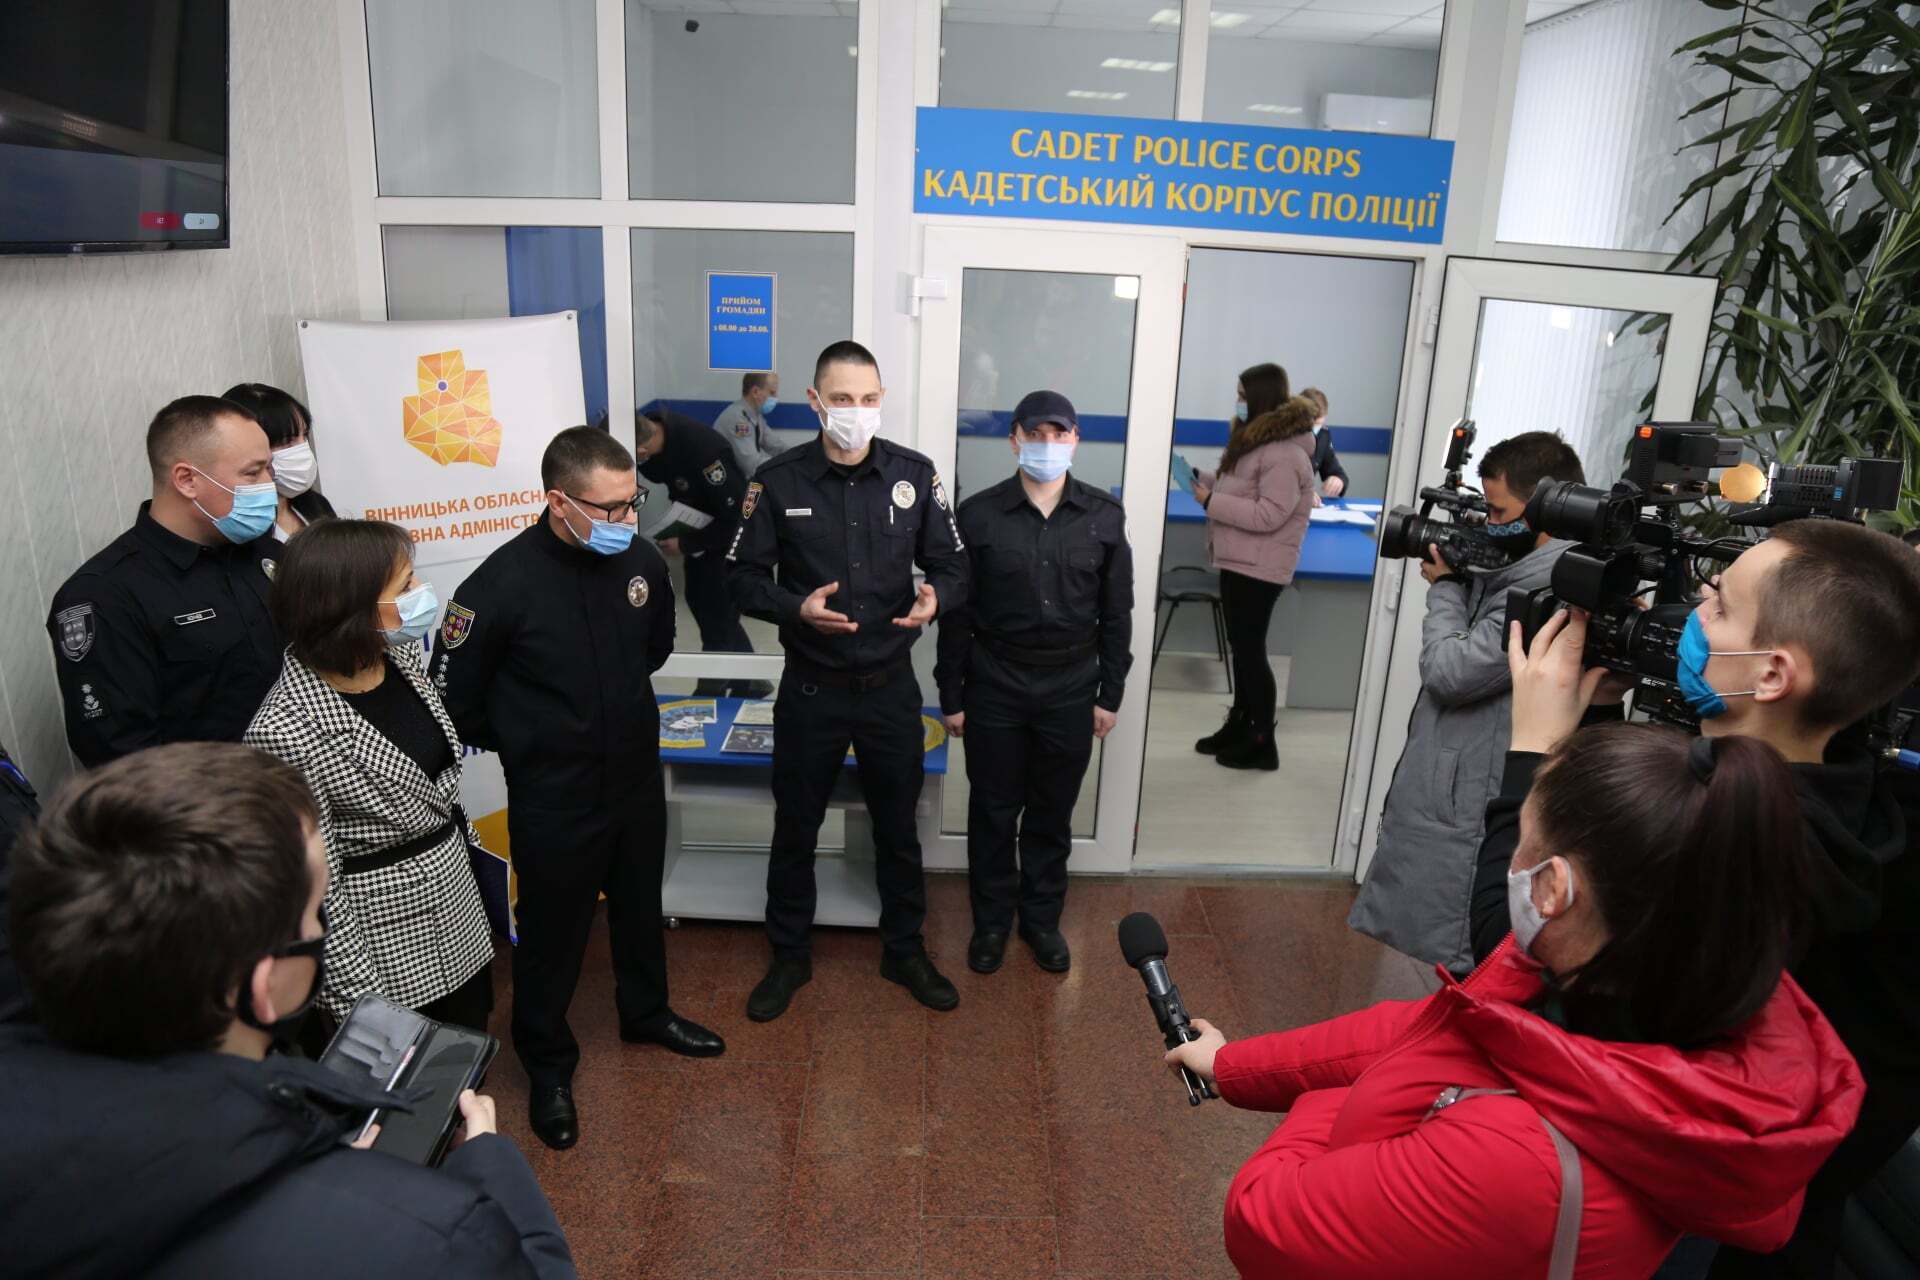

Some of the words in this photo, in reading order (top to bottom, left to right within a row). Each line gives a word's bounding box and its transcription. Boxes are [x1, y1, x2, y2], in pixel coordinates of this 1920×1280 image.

[1011, 128, 1123, 162] CADET
[1134, 135, 1250, 173] POLICE
[1254, 144, 1362, 178] CORPS
[923, 168, 1154, 208] КАДЕТСЬКИЙ
[1166, 183, 1301, 217] КОРПУС
[1310, 191, 1441, 232] ПОЛІЦІЇ
[716, 306, 766, 314] ГРОМАДЯН
[721, 296, 761, 305] ПРИЙОМ
[365, 499, 470, 521] ВІННИЦЬКА
[409, 526, 445, 544] ВНА
[450, 513, 540, 539] АДМІНІСТР
